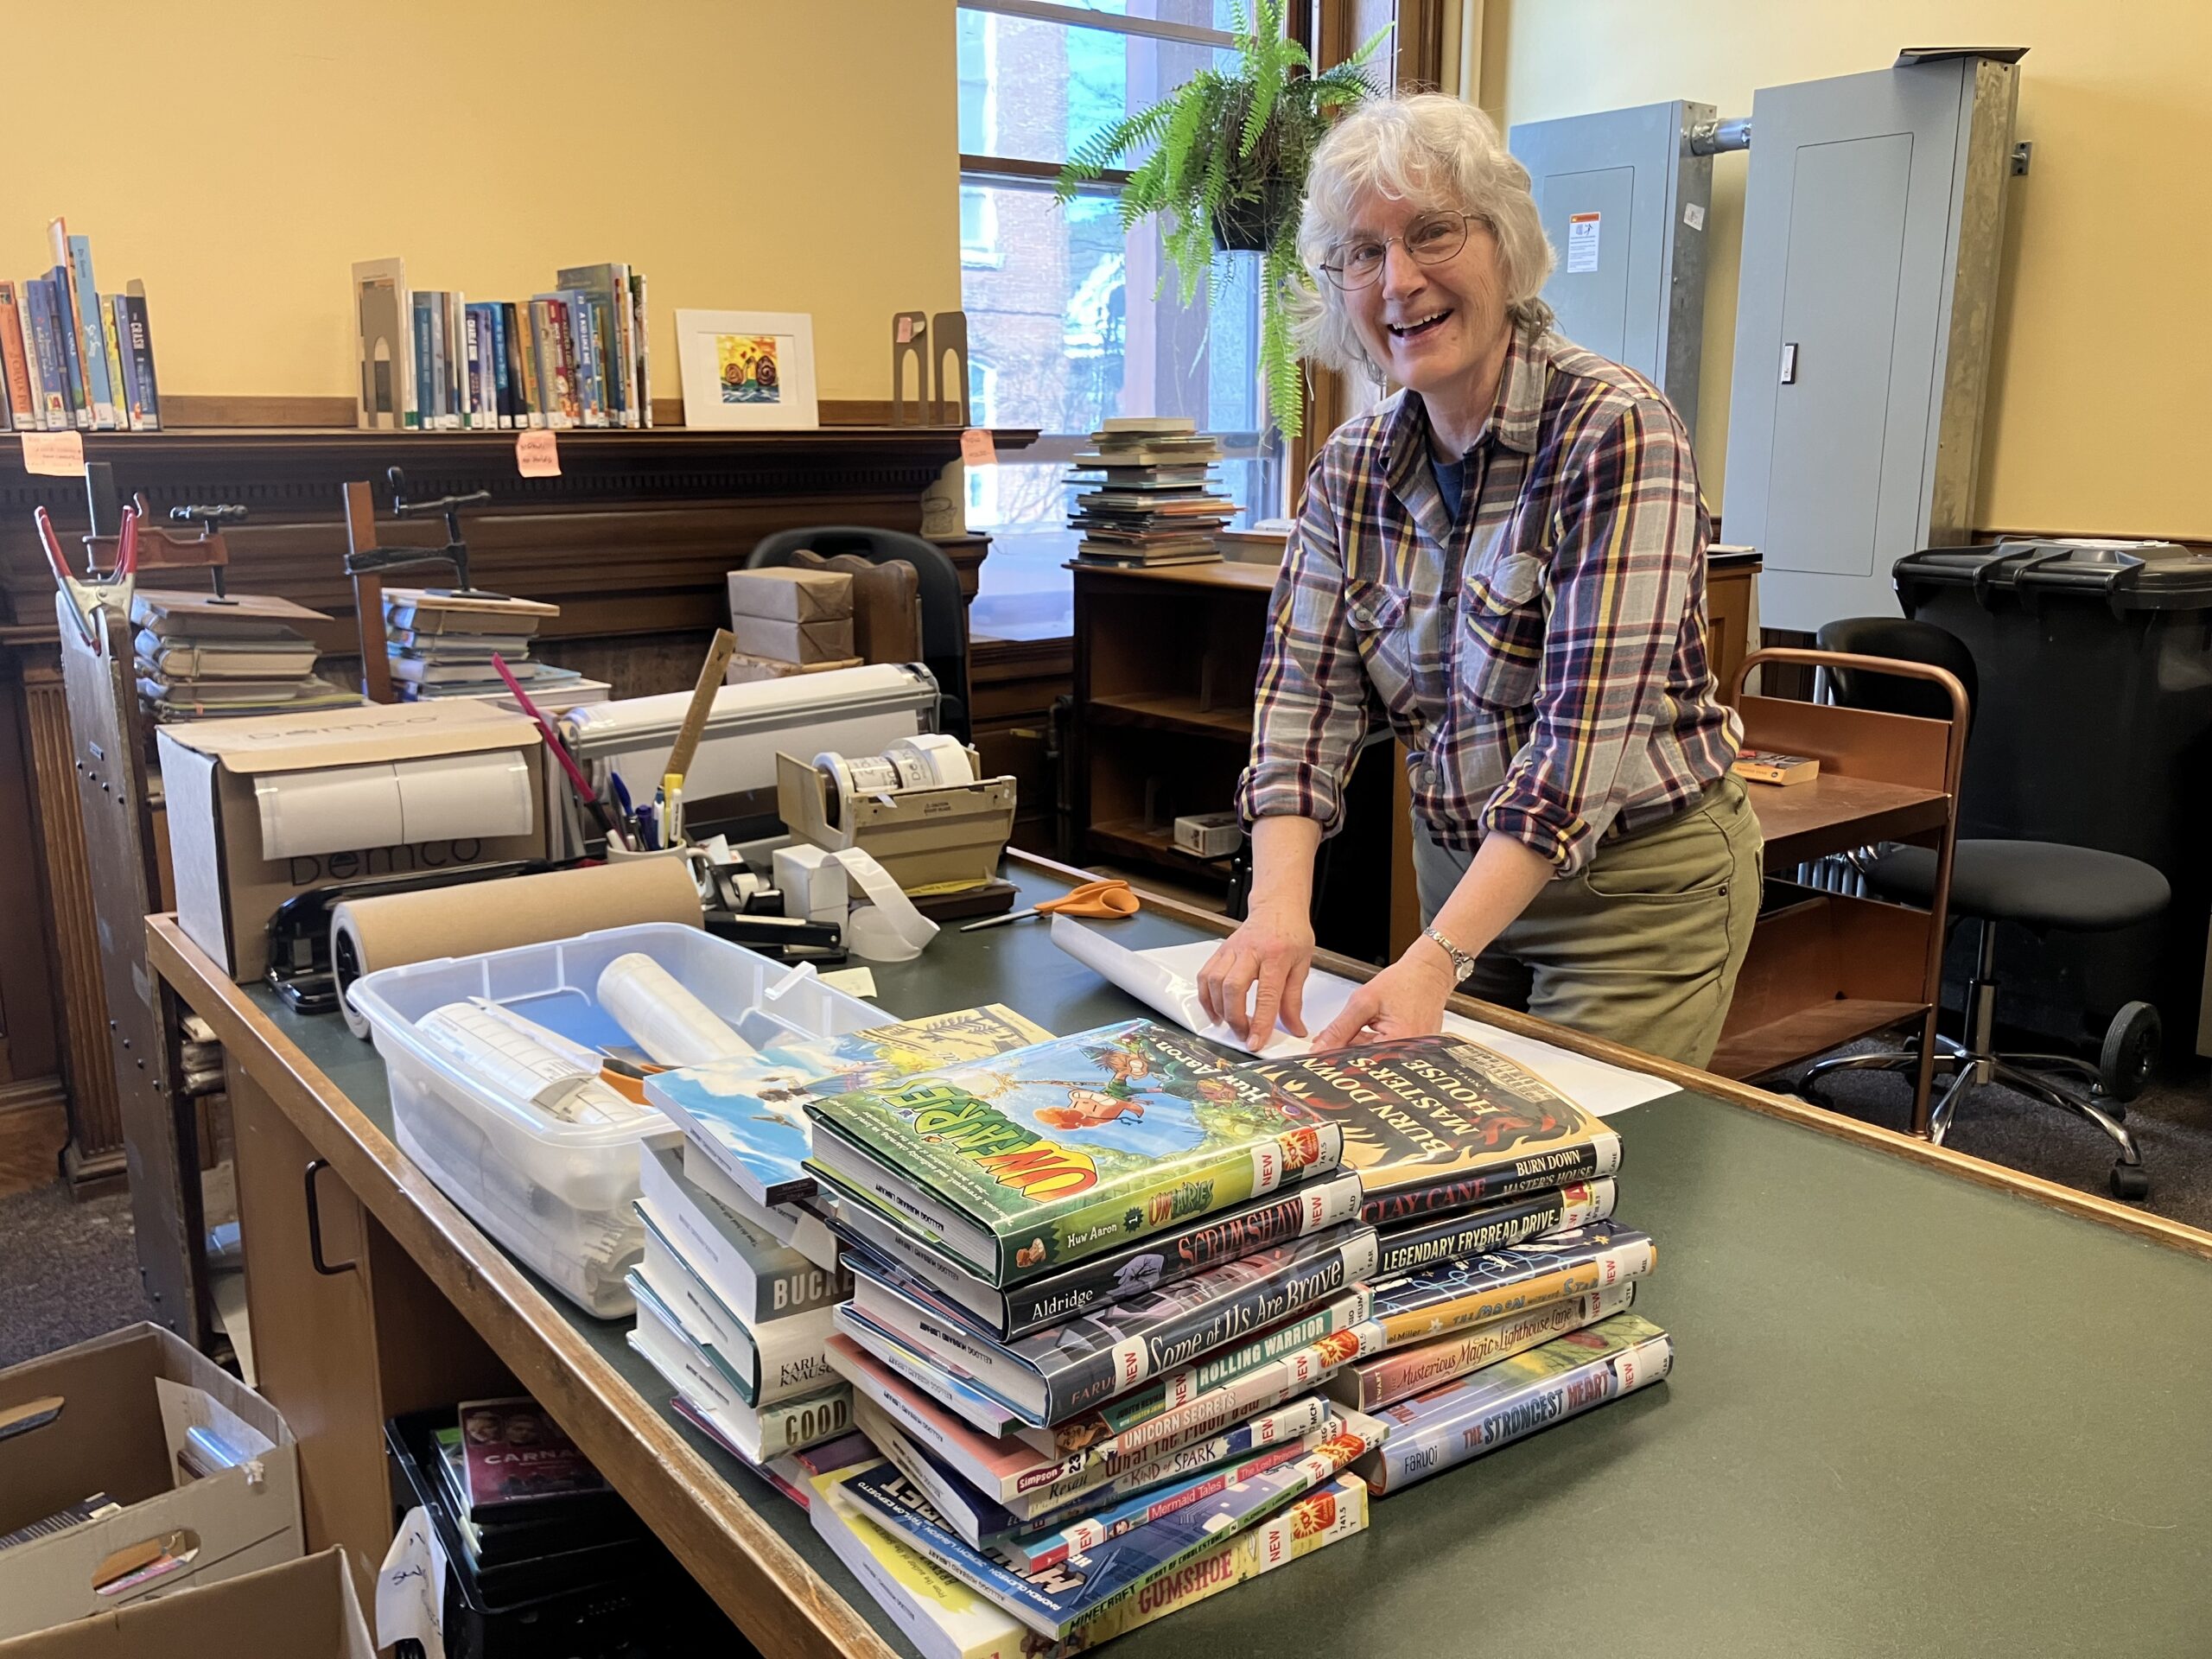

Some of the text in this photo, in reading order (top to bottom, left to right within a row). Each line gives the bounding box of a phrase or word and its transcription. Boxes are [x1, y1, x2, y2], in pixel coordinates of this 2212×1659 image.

[248, 715, 438, 741] Demco
[289, 837, 481, 887] Demco
[1154, 1036, 1272, 1103] Huw Aaron
[1348, 1057, 1479, 1136] MASTER'S
[1402, 1058, 1501, 1116] HOUSE
[1294, 1057, 1455, 1156] BURN DOWN
[1319, 1141, 1328, 1166] 741.5
[1516, 1150, 1581, 1178] BURN DOWN
[1261, 1154, 1273, 1188] NEW
[1502, 1165, 1594, 1195] MASTER'S HOUSE
[873, 1183, 896, 1201] LIBRARY
[1148, 1178, 1215, 1227] UNFAIRIES
[1348, 1194, 1357, 1213] ALD
[1362, 1178, 1487, 1224] CLAY CANE
[918, 1211, 945, 1231] KELLOGG
[1310, 1196, 1322, 1228] NEW
[1567, 1213, 1578, 1230] EW
[1066, 1223, 1117, 1249] Huw Aaron
[1178, 1197, 1304, 1262] SCRIMSHAW
[1383, 1207, 1564, 1271] LEGENDARY FRYBREAD DRIVE-I
[1367, 1248, 1376, 1270] FAR
[1605, 1259, 1616, 1287] NEW
[773, 1270, 855, 1311] BUCKE
[1032, 1287, 1094, 1321] Aldridge
[1477, 1295, 1527, 1318] MOON
[1562, 1277, 1599, 1297] STAR
[1148, 1259, 1341, 1374] Some of Us Are Brave
[1357, 1293, 1365, 1322] HEUM
[1592, 1292, 1600, 1319] NEW
[1396, 1328, 1423, 1344] Miller
[1398, 1305, 1573, 1389] Mysterious Magic Lighthouse Lane
[965, 1346, 994, 1364] KELLOGG
[1199, 1346, 1262, 1386] ROLLING
[1263, 1316, 1325, 1358] WARRIOR
[780, 1357, 818, 1376] KARL
[1124, 1351, 1139, 1385] NEW
[1296, 1355, 1308, 1384] NEW
[1624, 1363, 1634, 1389] NEW
[1176, 1373, 1187, 1408] NEW
[785, 1398, 848, 1446] GOOD
[1123, 1390, 1237, 1450] UNICORN SECRETS
[1308, 1402, 1319, 1424] MCN
[1462, 1370, 1611, 1450] THE STRONGEST HEART
[484, 1449, 577, 1465] CARNA
[1068, 1453, 1082, 1475] 23
[1104, 1446, 1149, 1478] What
[1130, 1440, 1217, 1486] KIND of SPARK
[1241, 1445, 1303, 1479] The Lost Princess
[1306, 1461, 1325, 1481] EW
[1403, 1446, 1439, 1475] FARUQI
[1019, 1466, 1059, 1489] Simpson
[856, 1479, 895, 1508] ESPOSITO
[1151, 1480, 1223, 1519] Mermaid Tales
[892, 1502, 924, 1527] TAYLOR
[1074, 1527, 1092, 1550] EW
[1268, 1530, 1281, 1563] NEW
[907, 1557, 927, 1577] author
[926, 1548, 953, 1568] LIBRARY
[954, 1543, 988, 1568] JEREMY
[922, 1574, 934, 1586] the
[950, 1562, 979, 1585] HUBBARD
[1069, 1531, 1224, 1632] MINECRAFT HEART OF COBBLESTONE
[1137, 1549, 1234, 1614] GUMSHOE
[930, 1582, 947, 1599] From
[1026, 1586, 1062, 1613] ANDREW
